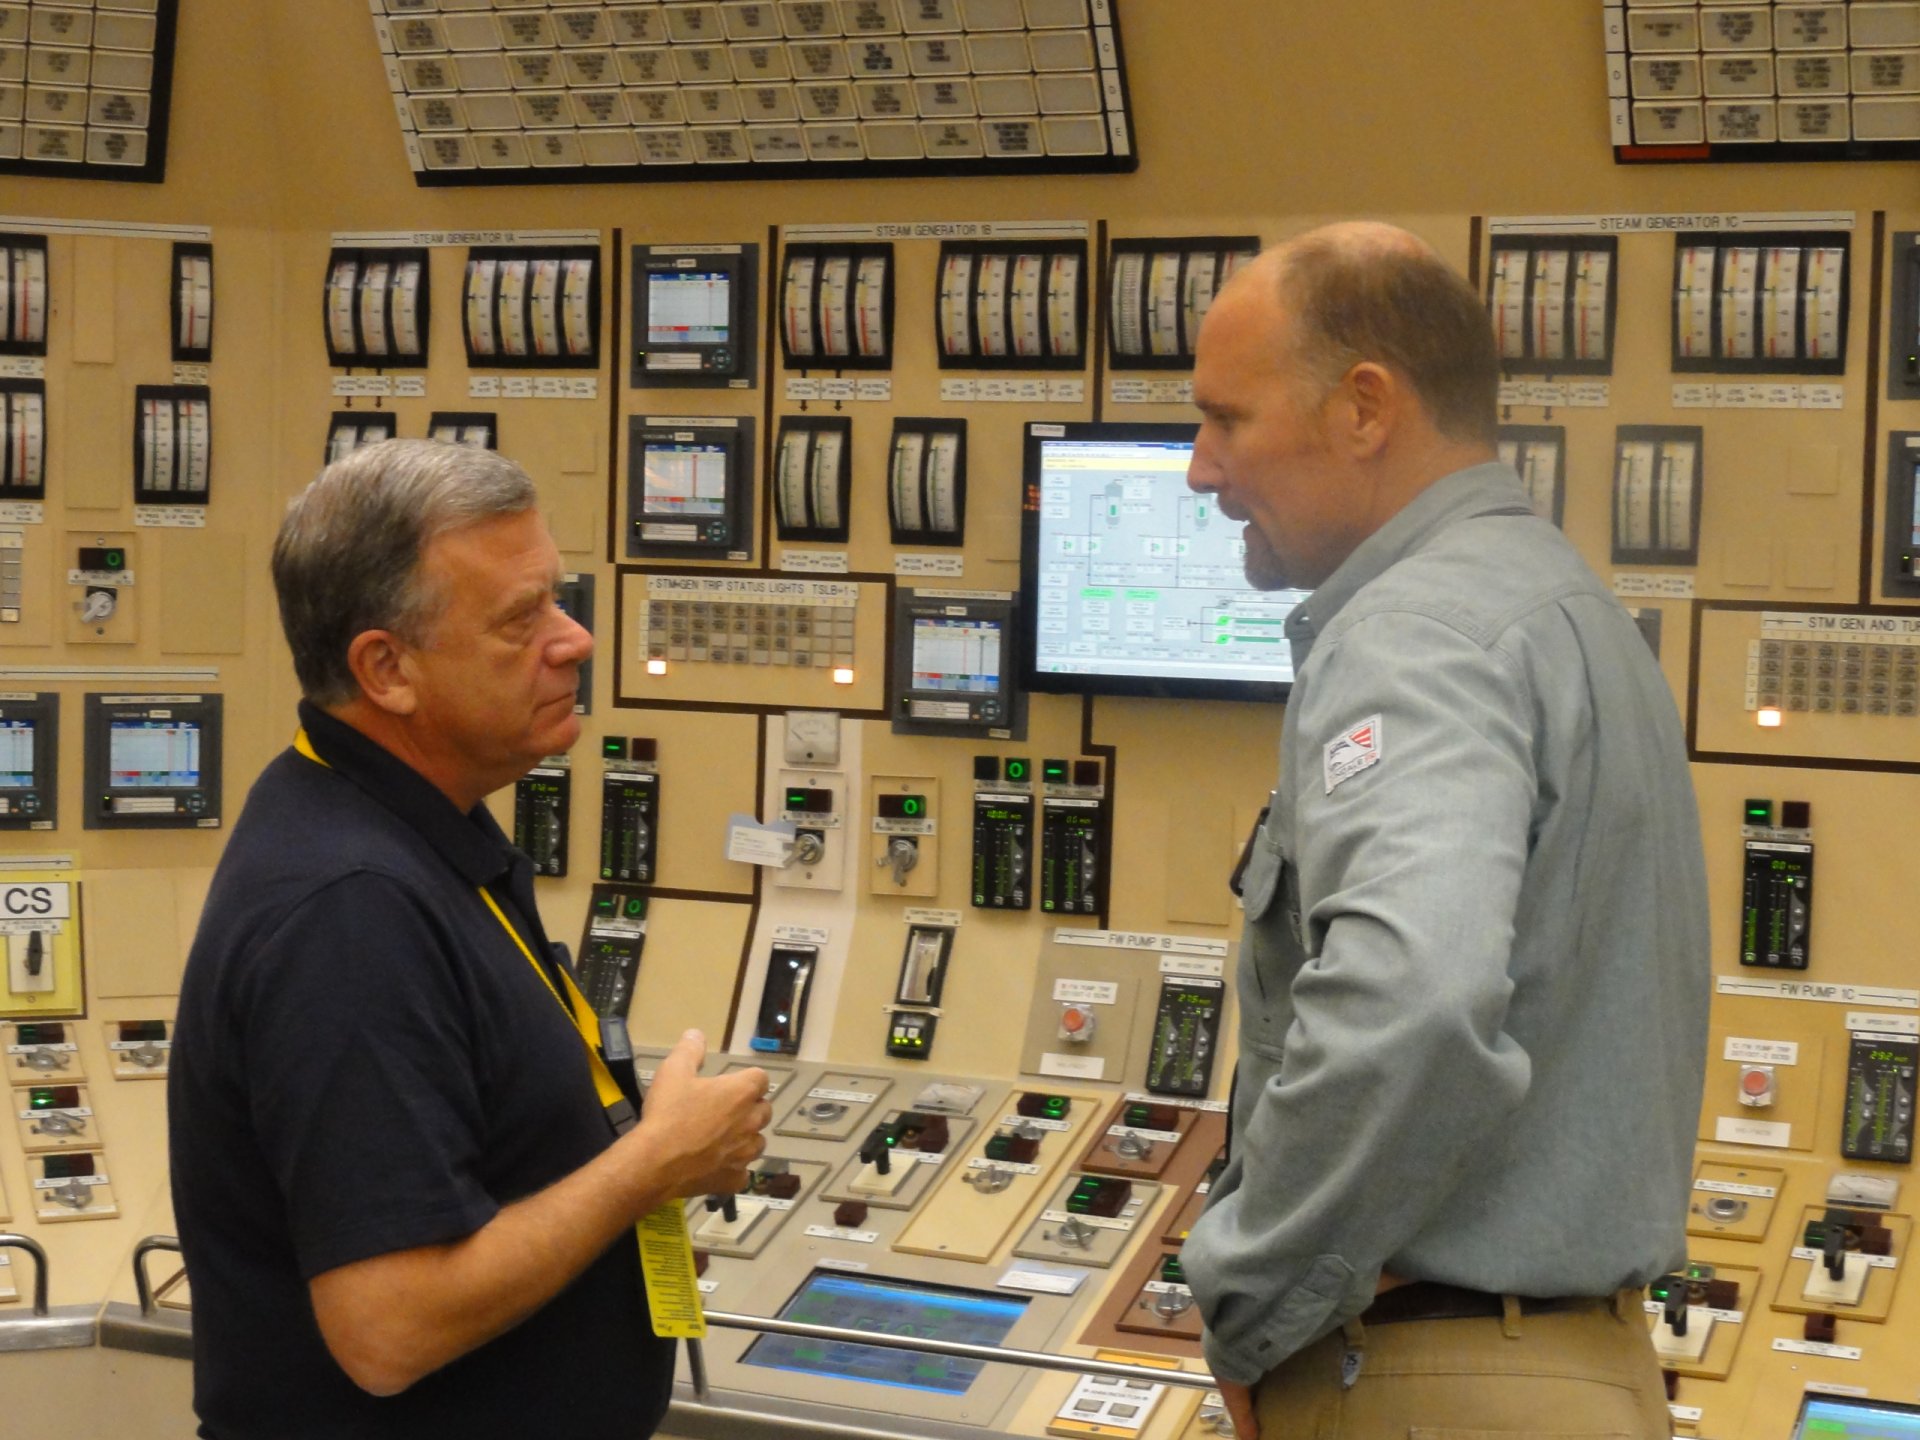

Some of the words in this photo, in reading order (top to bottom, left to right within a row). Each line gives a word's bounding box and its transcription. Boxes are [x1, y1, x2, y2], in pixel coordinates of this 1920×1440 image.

[1600, 217, 1642, 229] STEAM
[1646, 215, 1720, 229] GENERATOR
[1725, 215, 1738, 228] 1C
[875, 225, 912, 236] STEAM
[915, 224, 977, 236] GENERATOR
[413, 233, 444, 244] STEAM
[447, 232, 501, 243] GENERATOR
[702, 580, 722, 590] TRIP
[727, 581, 765, 593] STATUS
[769, 582, 805, 594] LIGHTS
[1808, 616, 1835, 628] STM
[1840, 618, 1866, 630] GEN
[1871, 620, 1897, 631] AND
[5, 886, 53, 914] CS
[1108, 933, 1125, 944] FW
[1127, 935, 1157, 946] PUMP
[1780, 983, 1799, 995] FW
[1802, 985, 1837, 998] PUMP
[1842, 988, 1855, 1000] 1C
